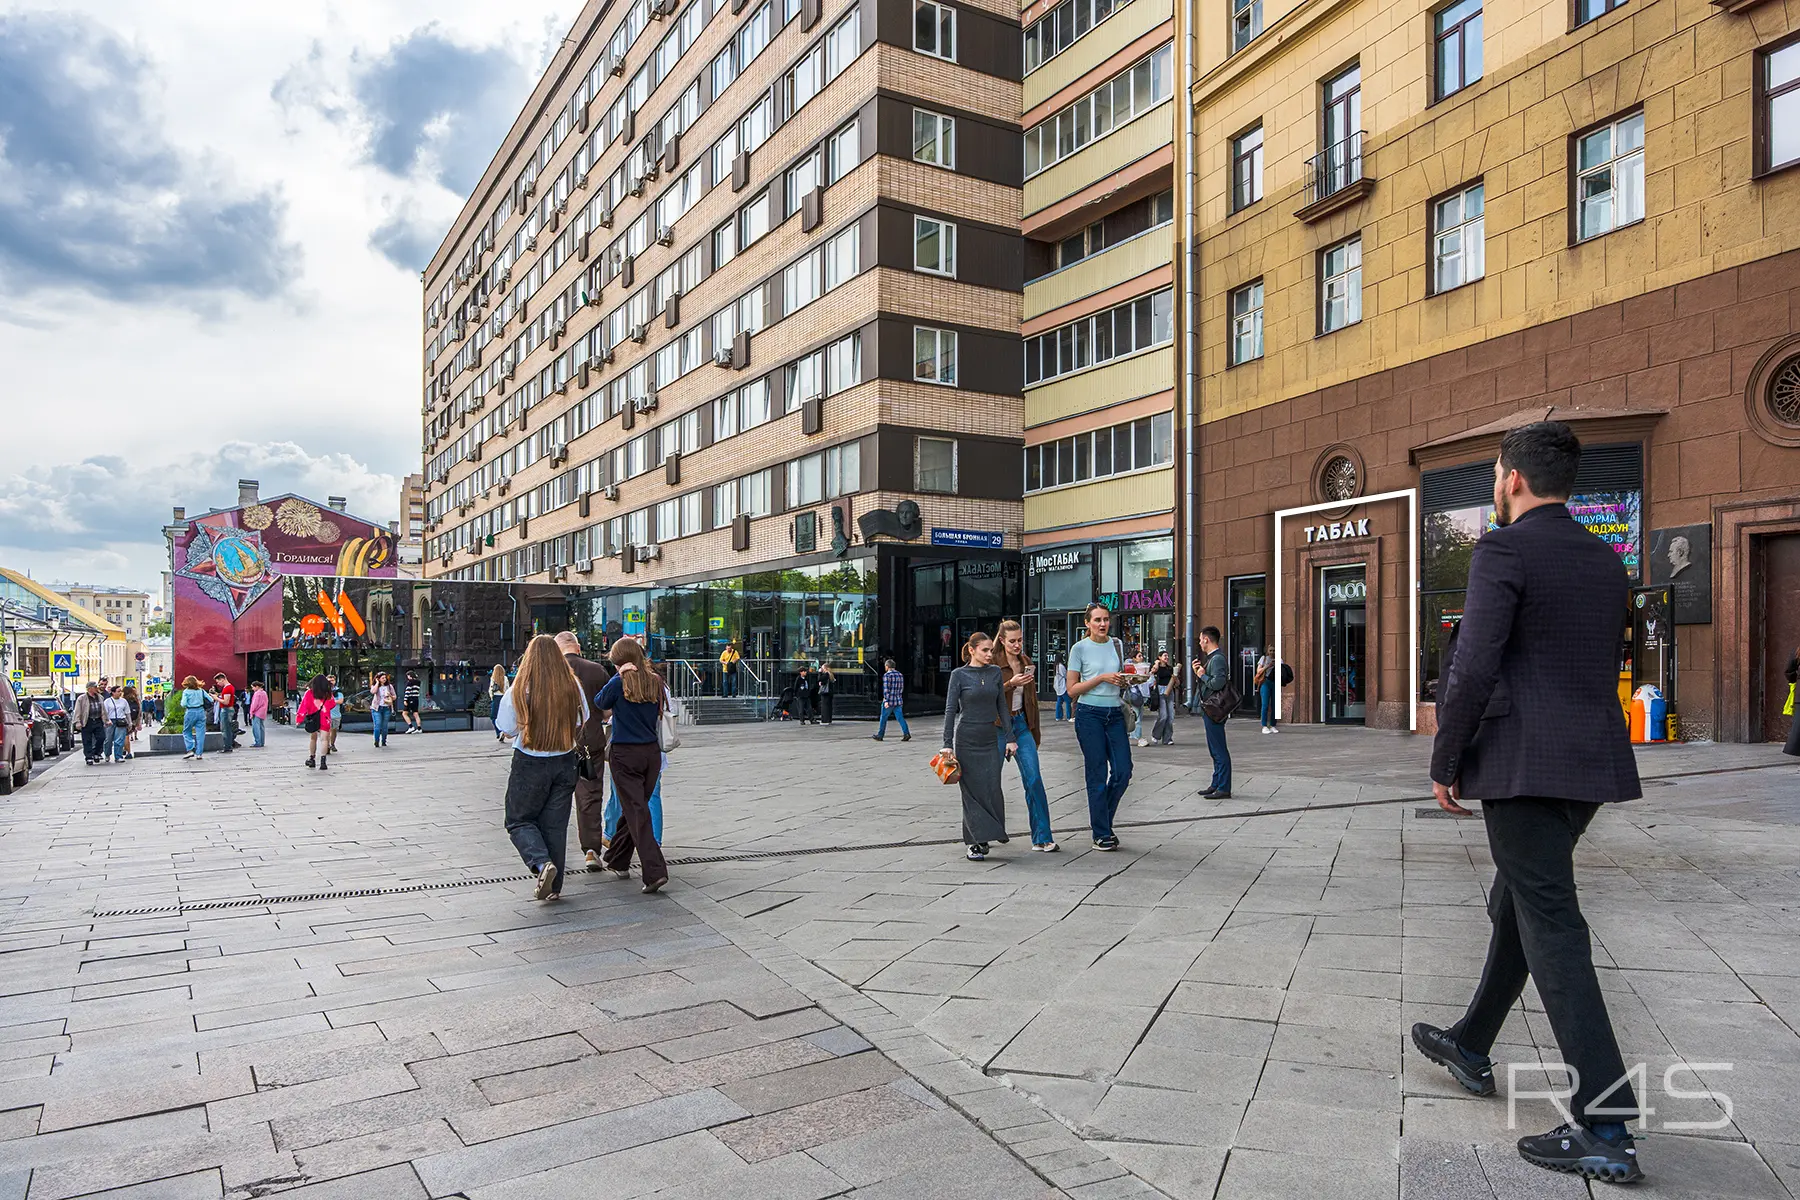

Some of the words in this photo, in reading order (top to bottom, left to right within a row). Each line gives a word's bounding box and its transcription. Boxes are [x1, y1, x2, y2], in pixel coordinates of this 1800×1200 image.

[1575, 514, 1616, 524] ШАУРМА
[934, 531, 962, 540] БОЛЬШАЯ
[962, 533, 988, 542] БРОННАЯ
[991, 535, 1002, 545] 29
[1304, 518, 1368, 542] ТАБАК
[1036, 551, 1080, 568] МосТАБАК
[1121, 588, 1174, 609] ТАБАК
[833, 600, 861, 632] Кафе
